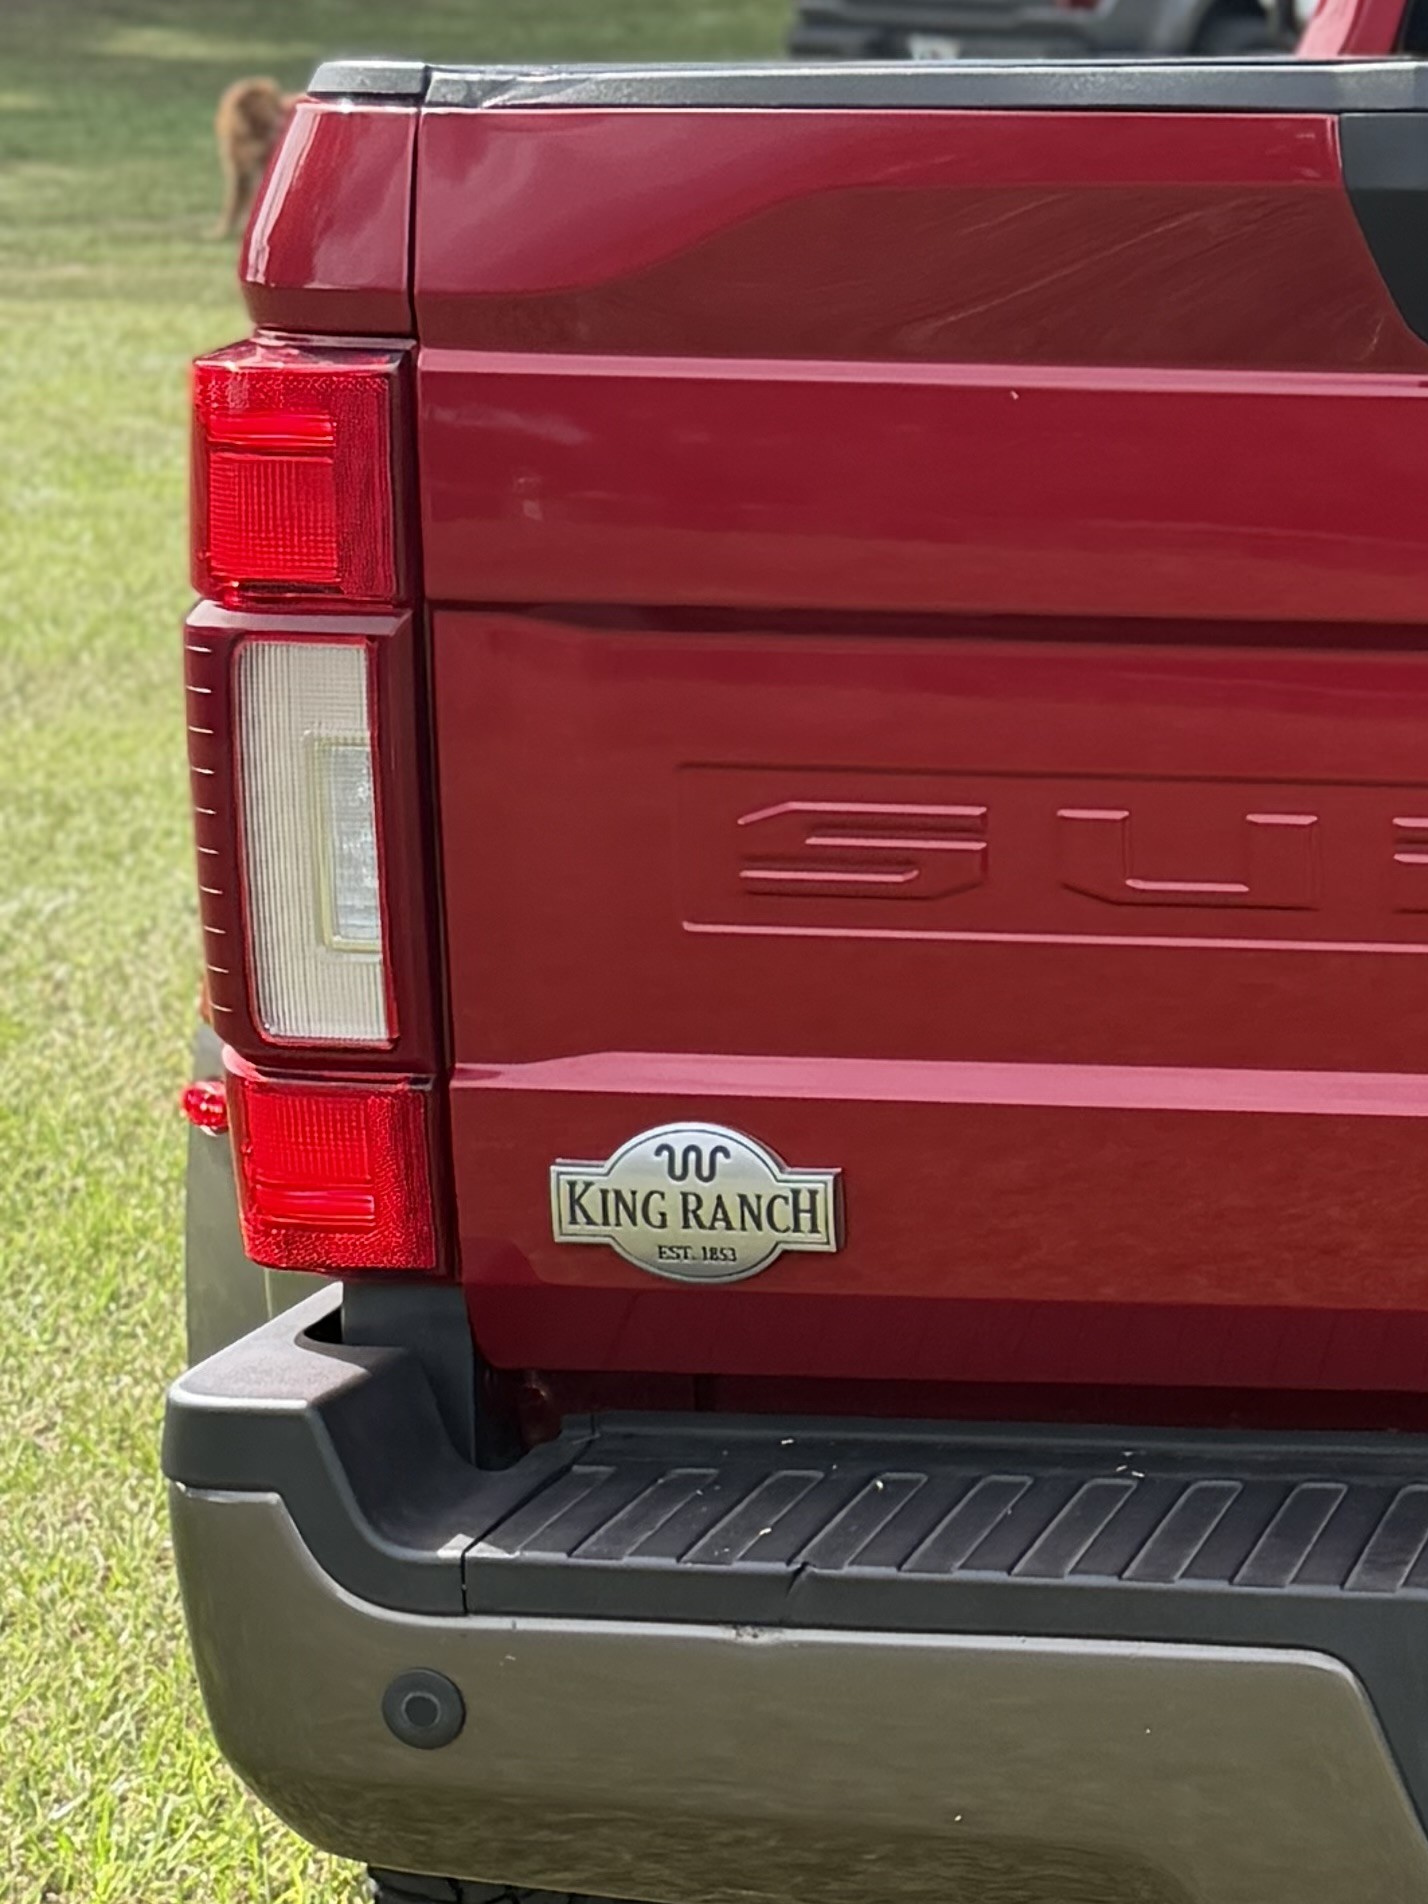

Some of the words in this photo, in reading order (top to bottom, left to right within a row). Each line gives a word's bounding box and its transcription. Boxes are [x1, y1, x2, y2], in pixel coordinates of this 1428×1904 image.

[567, 1180, 667, 1230] KING
[680, 1187, 822, 1235] RANCH
[657, 1246, 697, 1261] EST.
[702, 1246, 738, 1262] 1853
